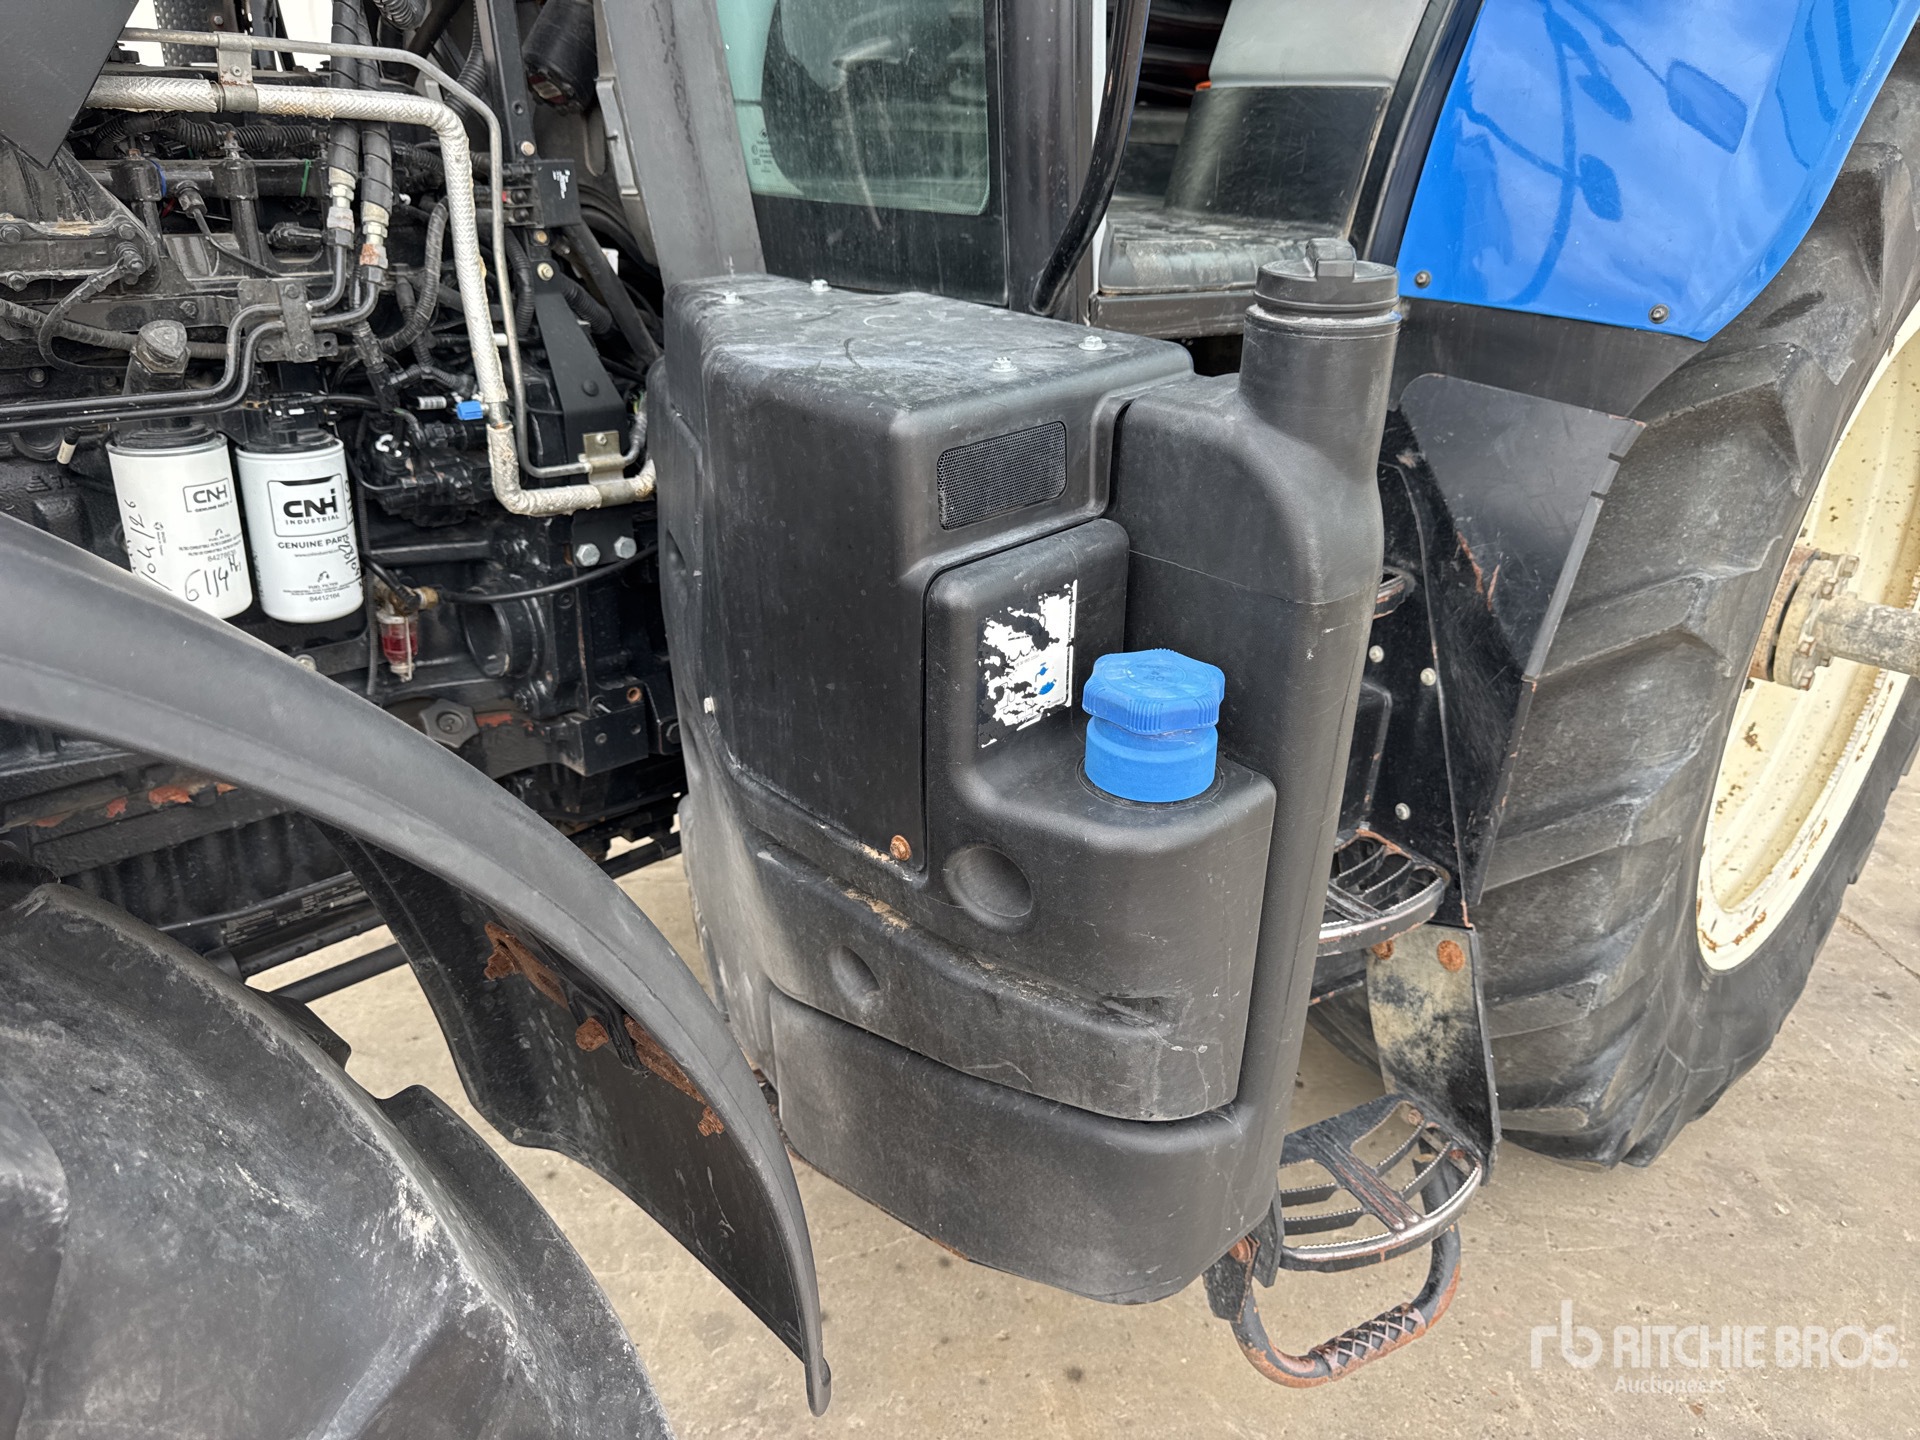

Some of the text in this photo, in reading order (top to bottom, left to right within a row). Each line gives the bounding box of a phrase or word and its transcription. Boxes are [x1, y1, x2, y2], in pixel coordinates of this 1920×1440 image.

[285, 515, 340, 526] INDUSTRIAL
[277, 533, 350, 550] GENUINE PARTS
